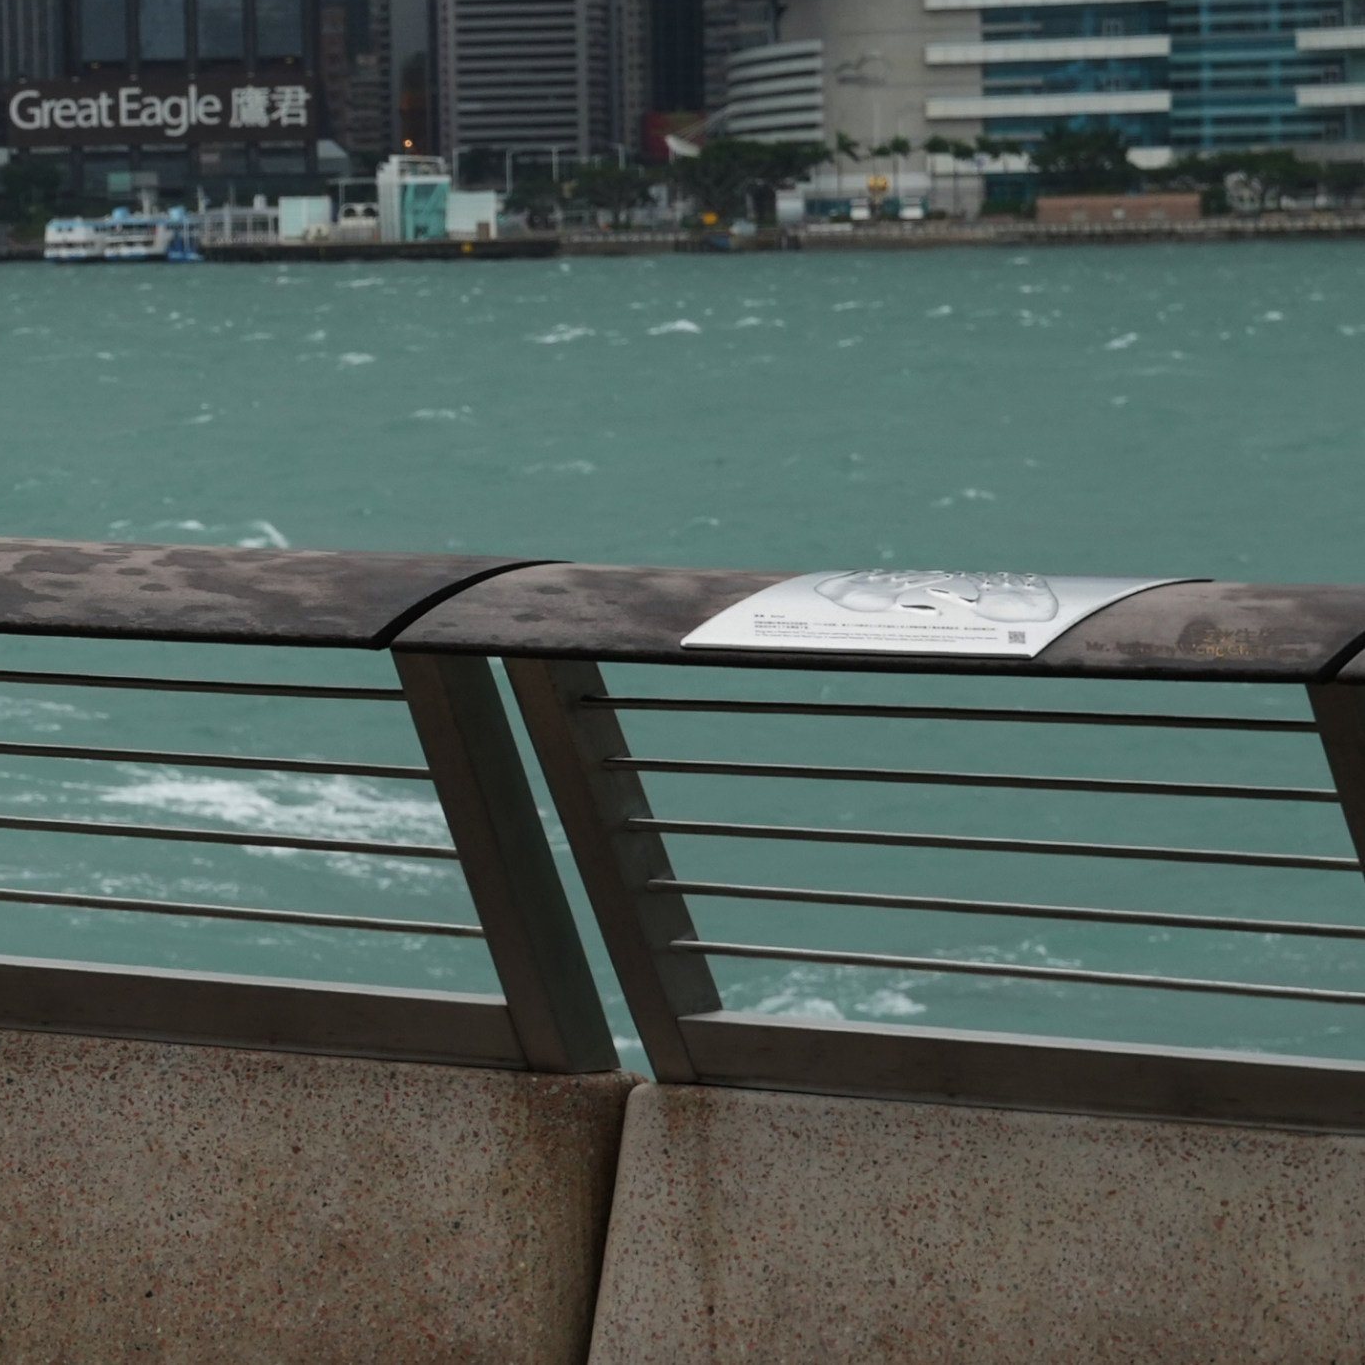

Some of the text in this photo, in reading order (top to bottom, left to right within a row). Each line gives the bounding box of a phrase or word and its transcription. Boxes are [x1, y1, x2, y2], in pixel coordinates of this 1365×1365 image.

[8, 84, 312, 138] Great Eagle 鷹君
